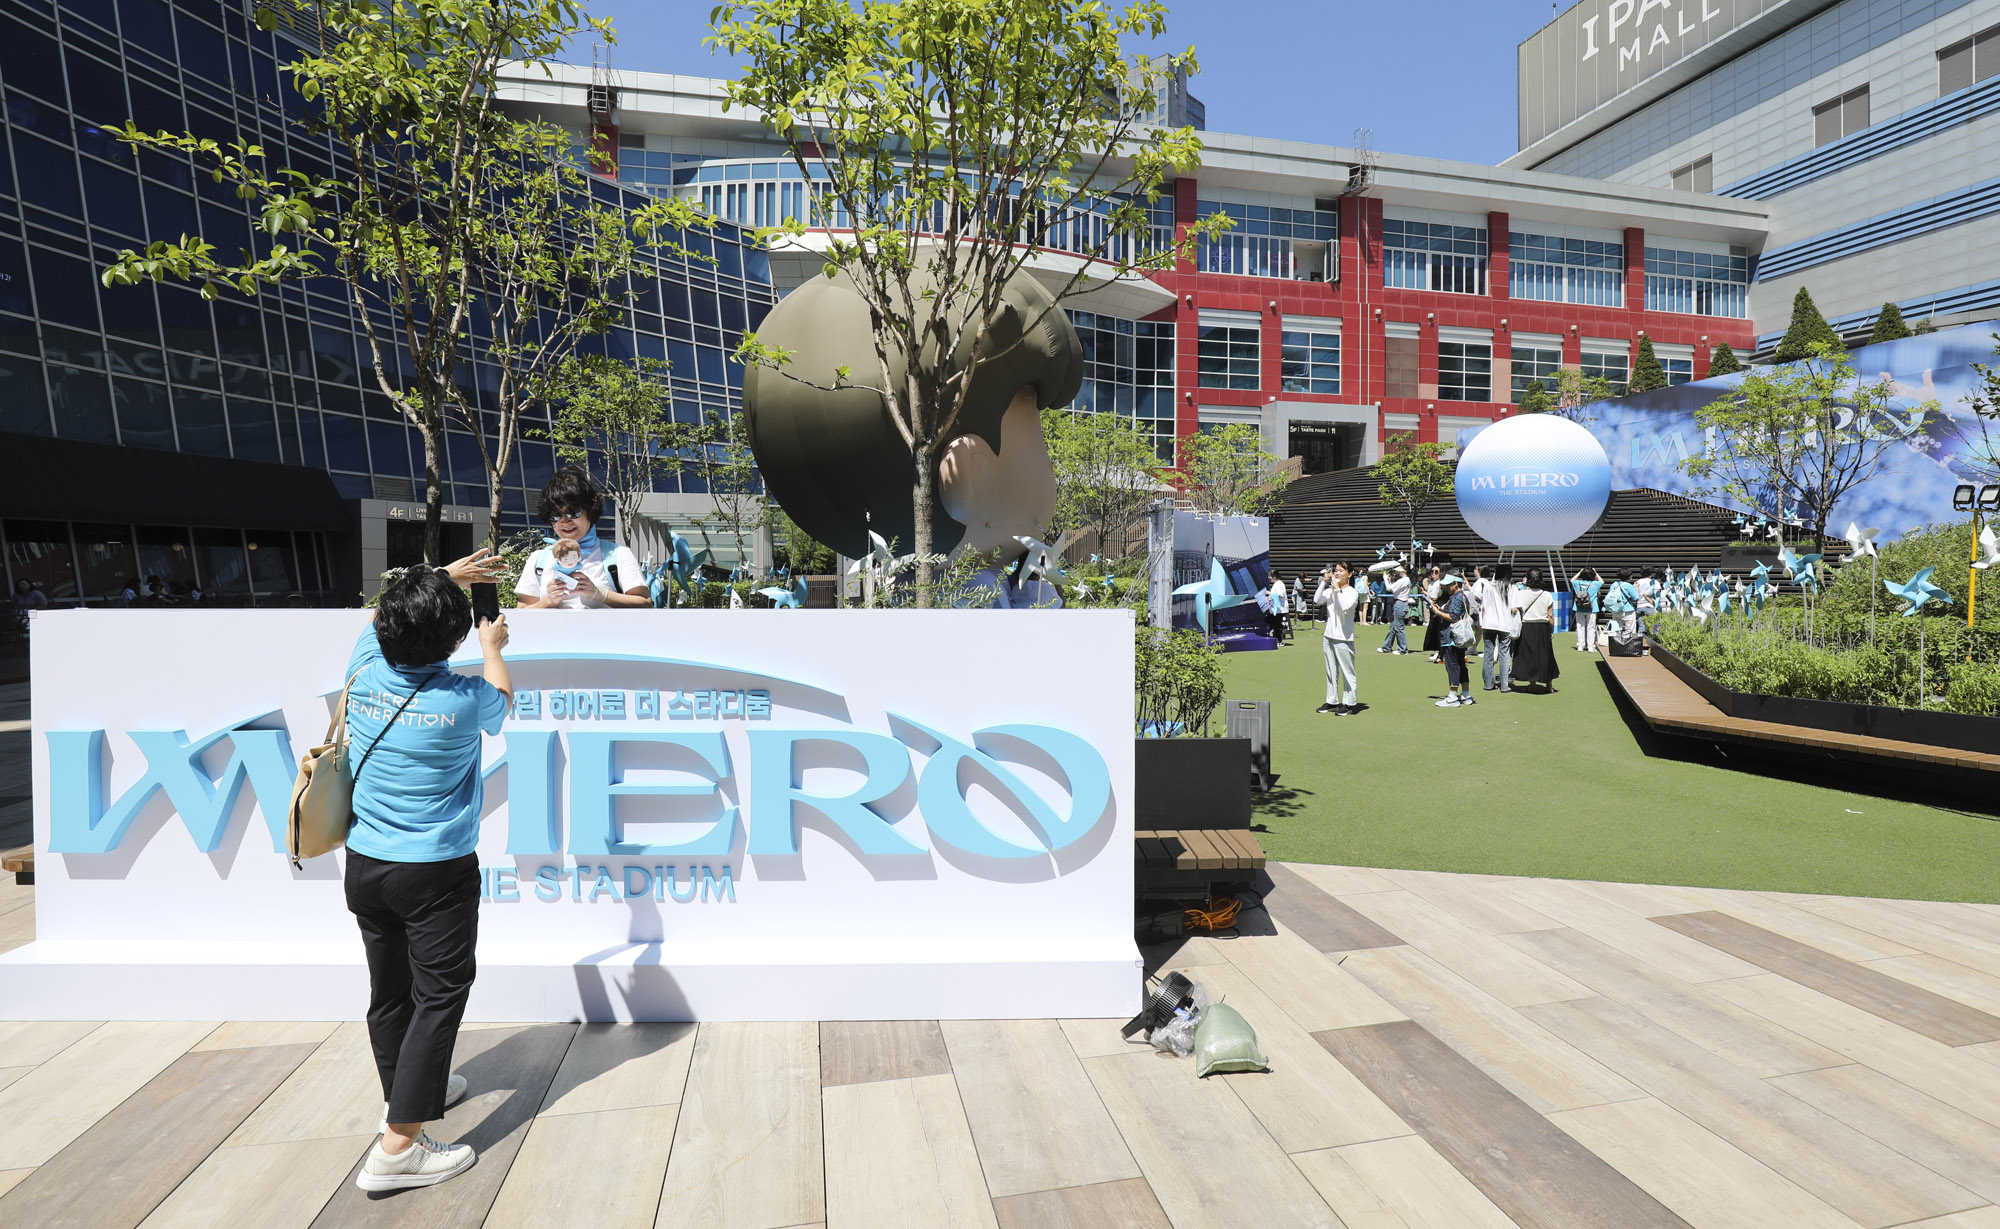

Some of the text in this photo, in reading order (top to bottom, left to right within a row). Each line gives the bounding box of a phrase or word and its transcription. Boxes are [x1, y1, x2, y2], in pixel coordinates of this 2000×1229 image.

[1620, 0, 1720, 72] MALL
[1500, 472, 1579, 488] HERO
[1515, 488, 1547, 496] STADIUM
[389, 506, 404, 518] 4F
[369, 689, 418, 709] HERO
[509, 689, 772, 716] 임 히어로 더 스타디움
[534, 866, 736, 900] STADIUM
